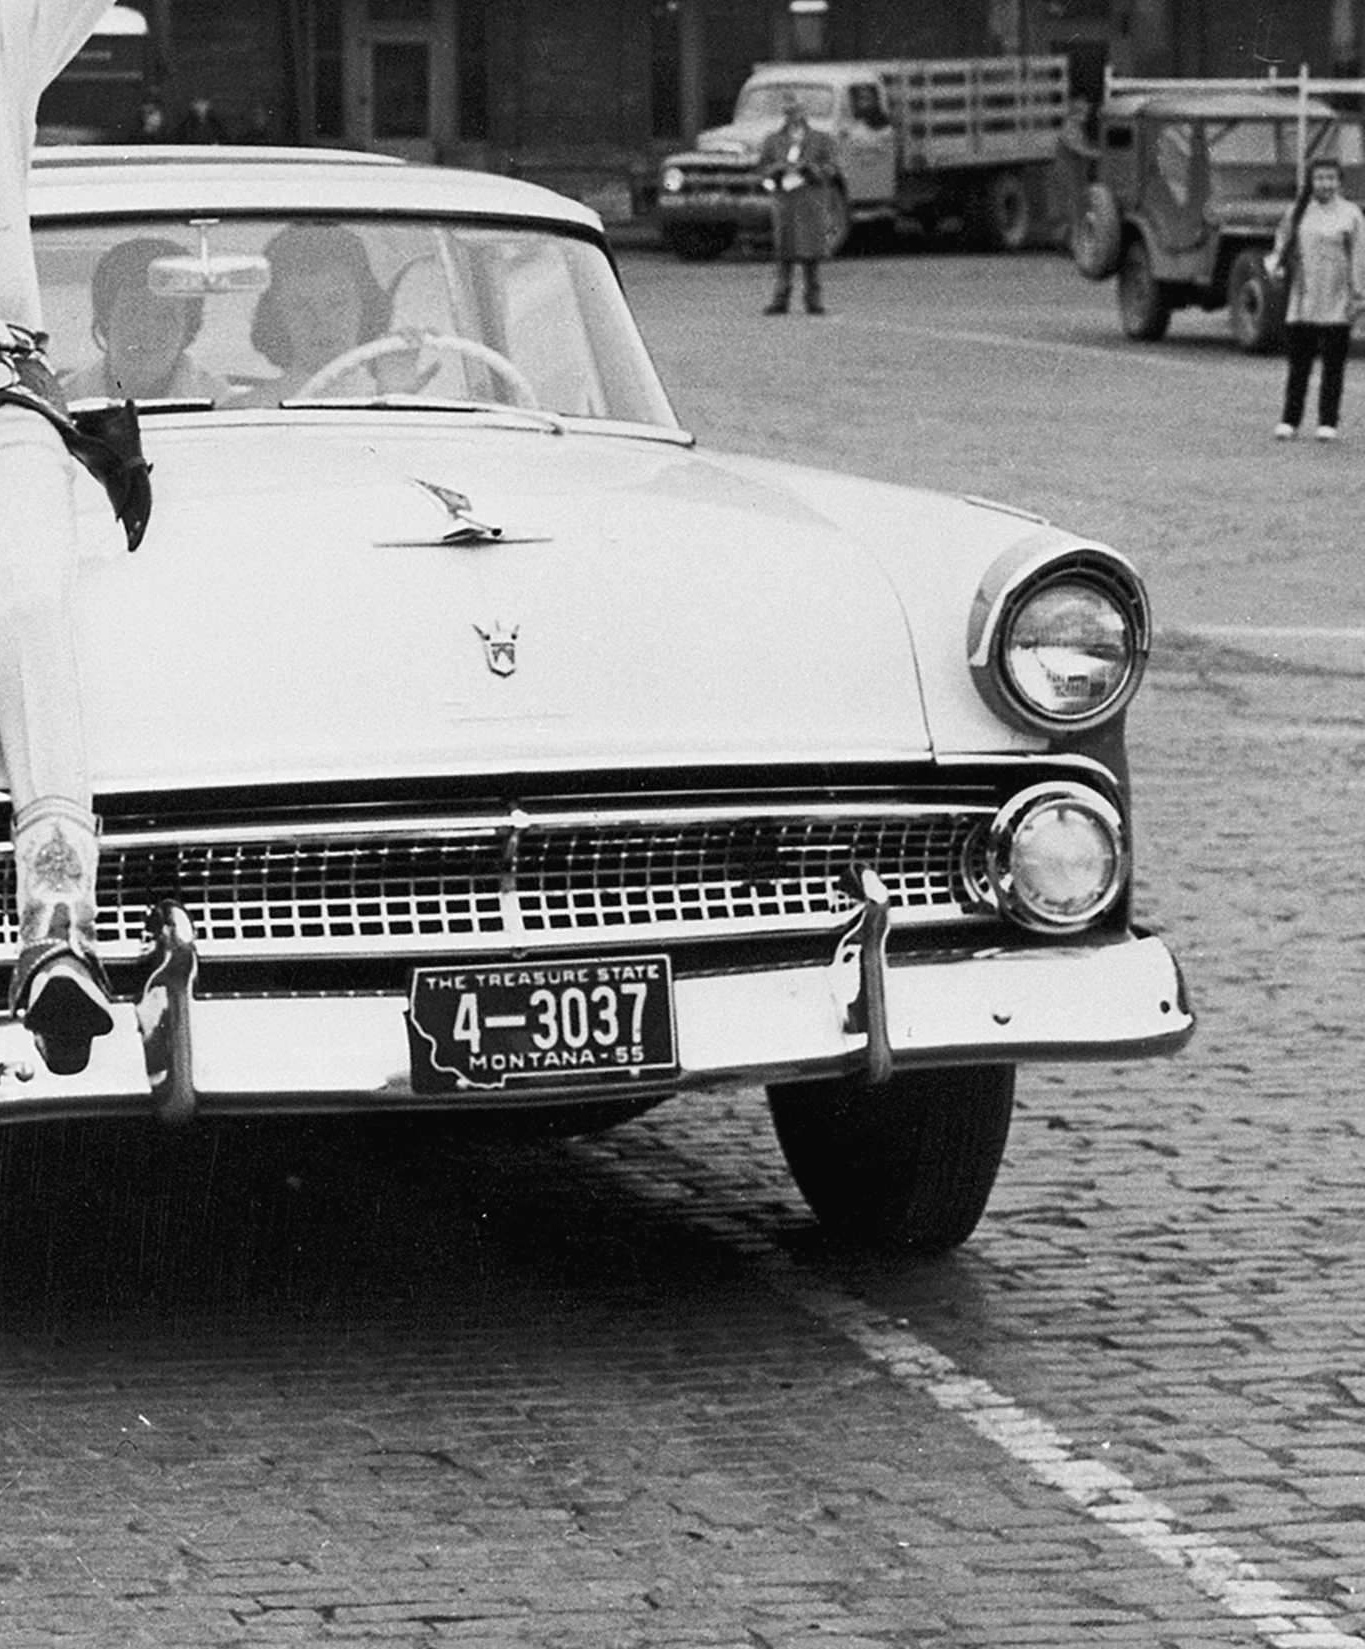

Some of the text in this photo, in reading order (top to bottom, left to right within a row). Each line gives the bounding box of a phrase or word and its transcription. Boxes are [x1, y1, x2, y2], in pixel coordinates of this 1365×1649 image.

[425, 964, 660, 991] THE TREASURE STATE
[452, 983, 648, 1054] 4-3037
